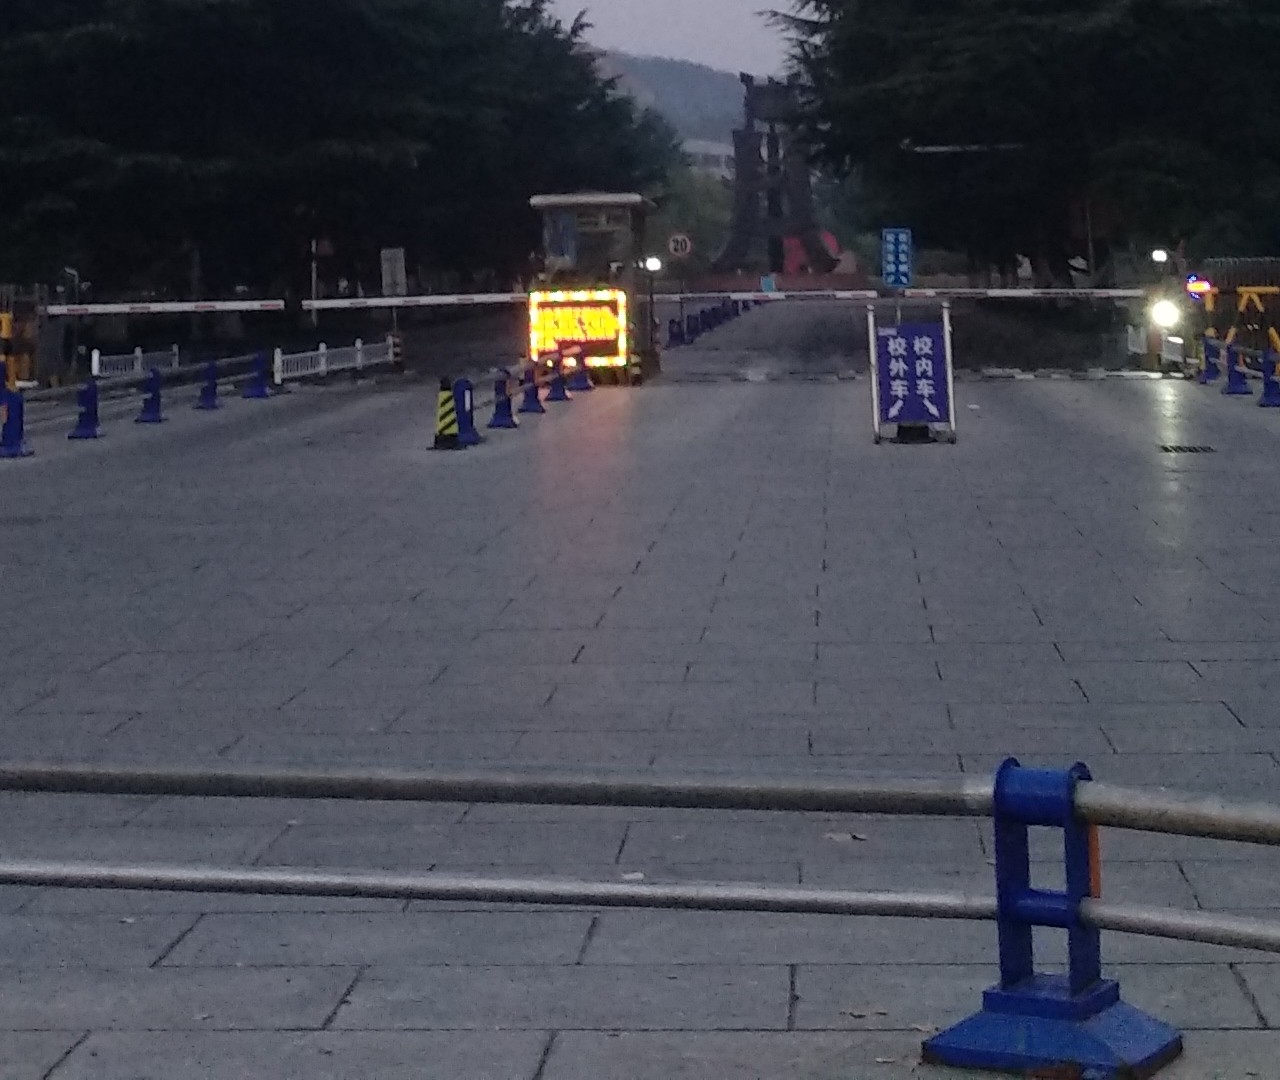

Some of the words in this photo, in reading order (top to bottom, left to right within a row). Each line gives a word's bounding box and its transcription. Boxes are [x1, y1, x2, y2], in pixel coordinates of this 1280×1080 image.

[672, 237, 687, 253] 20
[887, 335, 910, 399] 校外车
[913, 335, 936, 398] 校内车
